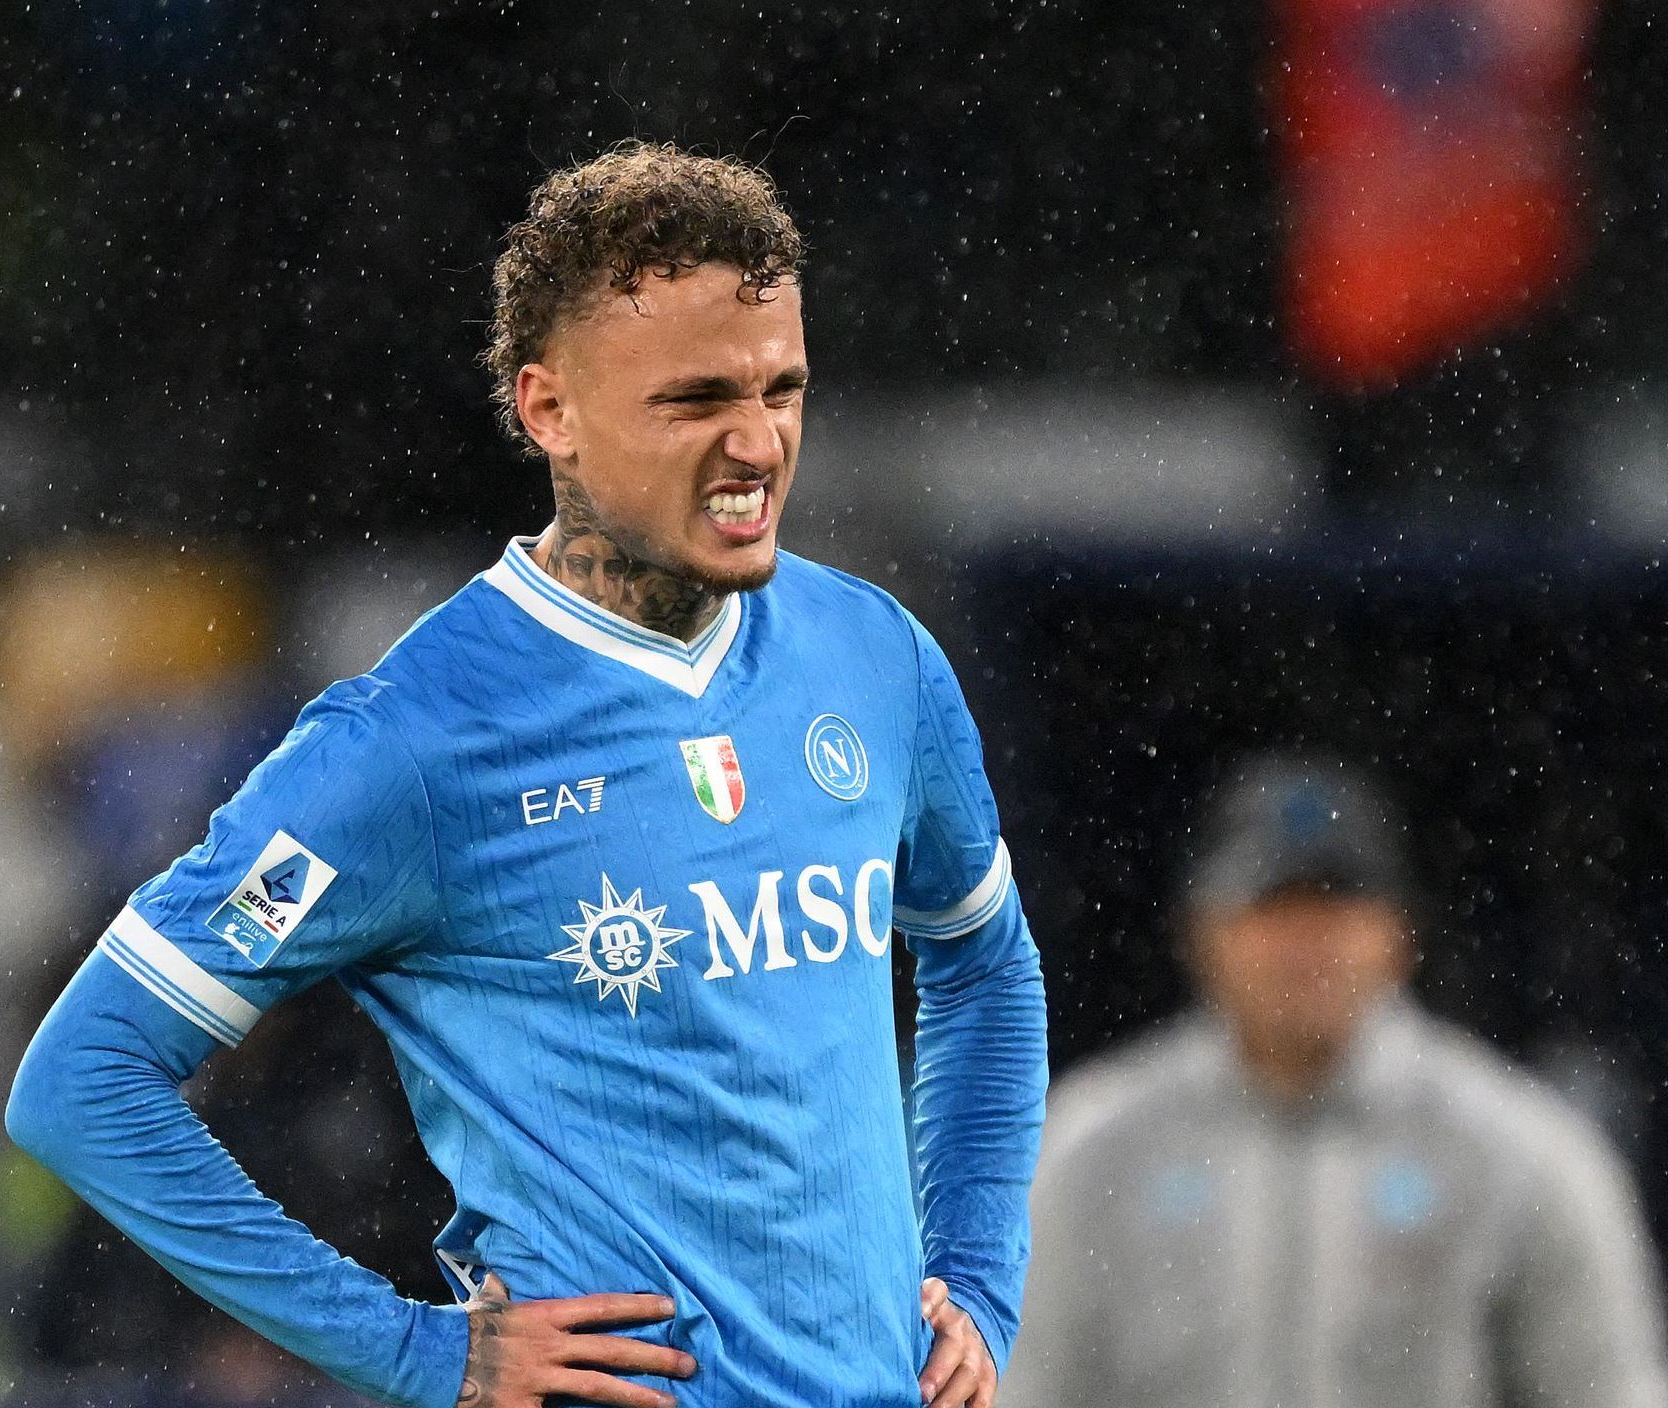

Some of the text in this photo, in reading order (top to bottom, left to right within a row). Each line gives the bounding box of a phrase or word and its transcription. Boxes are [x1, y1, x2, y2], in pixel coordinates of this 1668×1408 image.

[820, 738, 852, 778] N
[521, 776, 606, 825] EA7
[232, 912, 268, 942] enilive
[242, 890, 287, 927] SERIE A
[688, 858, 893, 981] MSC
